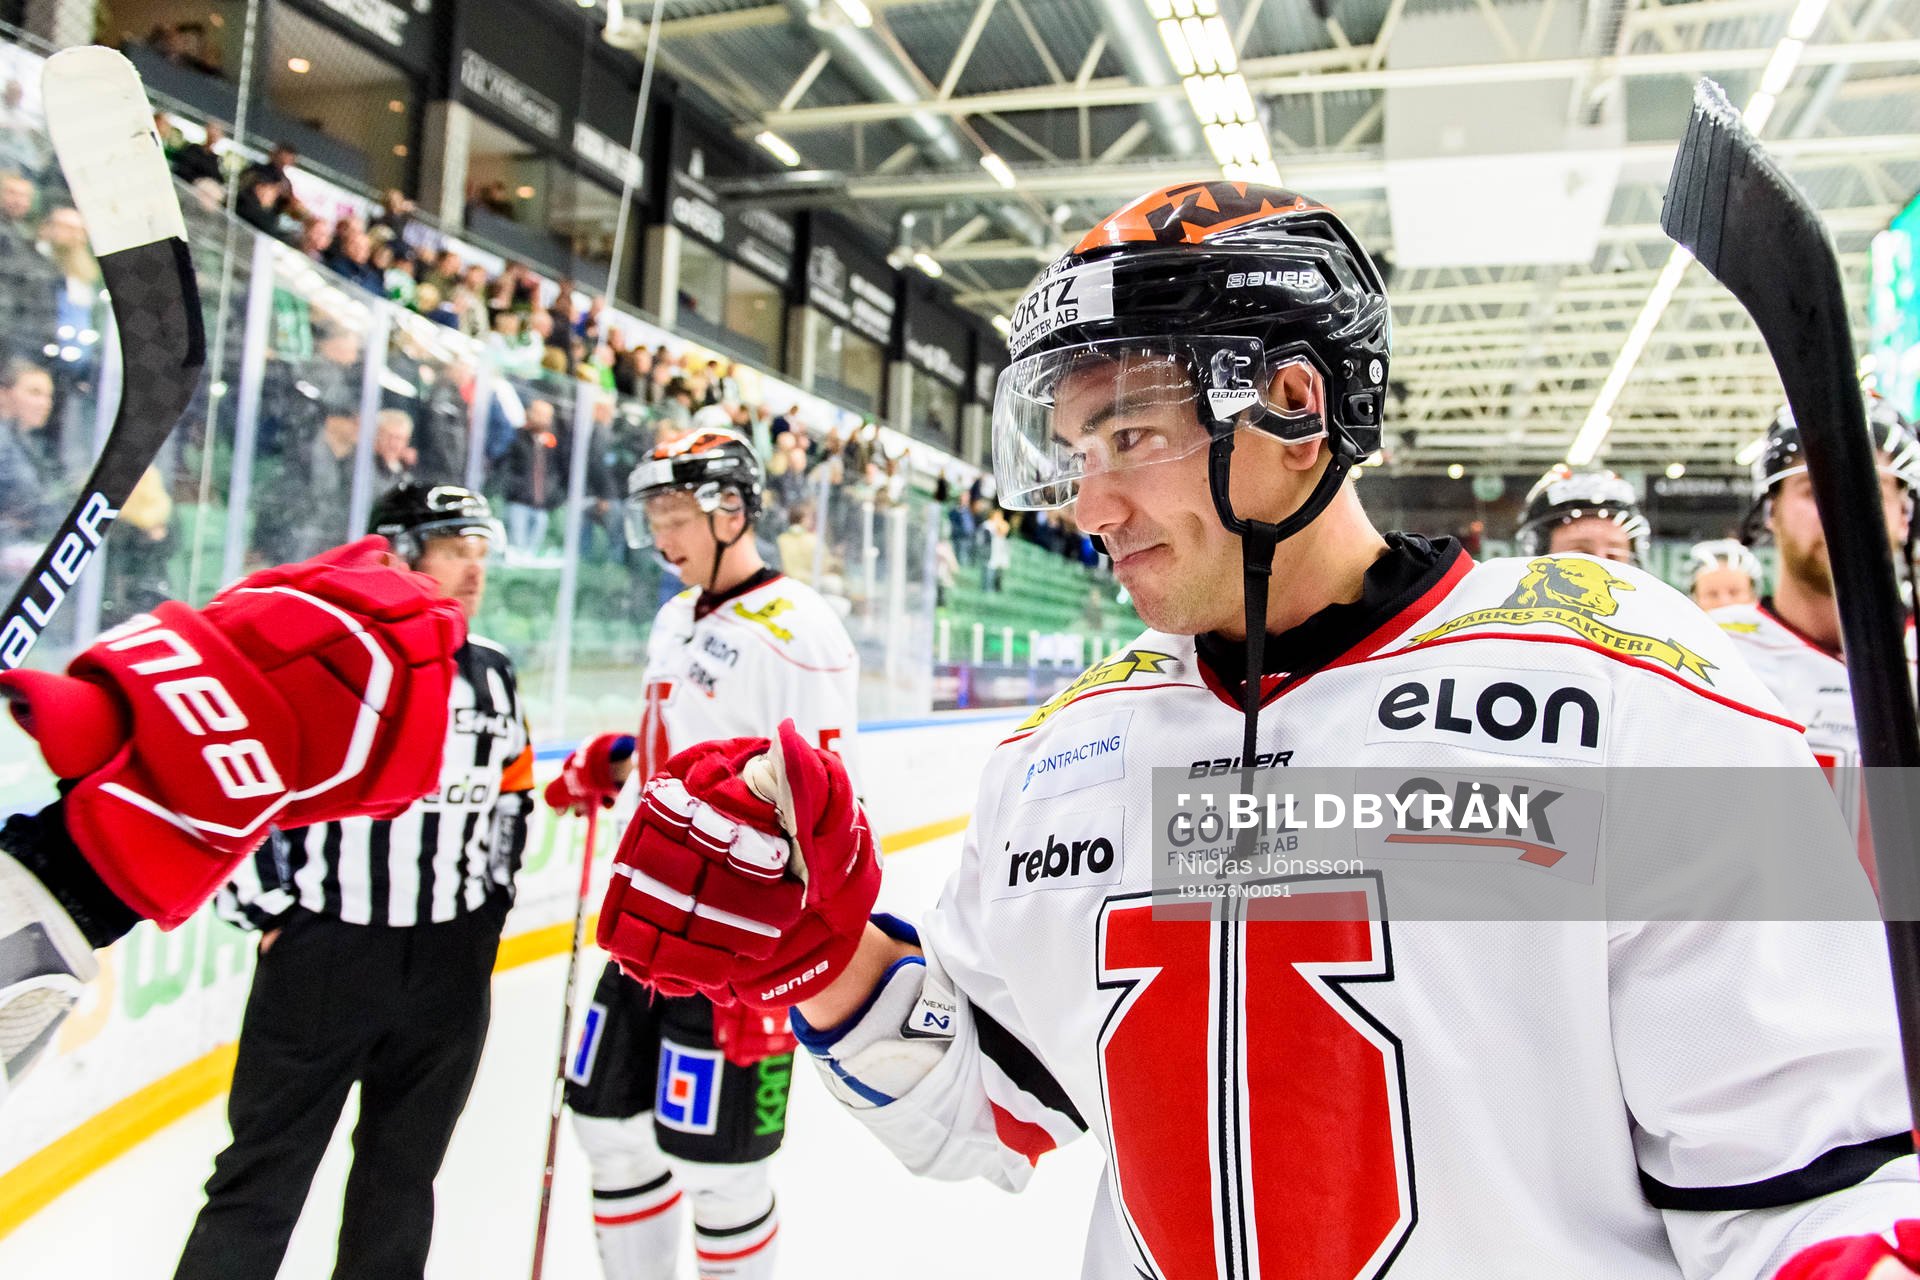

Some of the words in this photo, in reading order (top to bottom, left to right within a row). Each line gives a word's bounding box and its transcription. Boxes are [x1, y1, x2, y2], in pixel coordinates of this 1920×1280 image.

[1055, 308, 1078, 326] AB
[0, 492, 120, 670] AUER
[1543, 609, 1653, 652] SLAKTERI
[1006, 834, 1114, 887] rebro
[1274, 835, 1299, 852] AB
